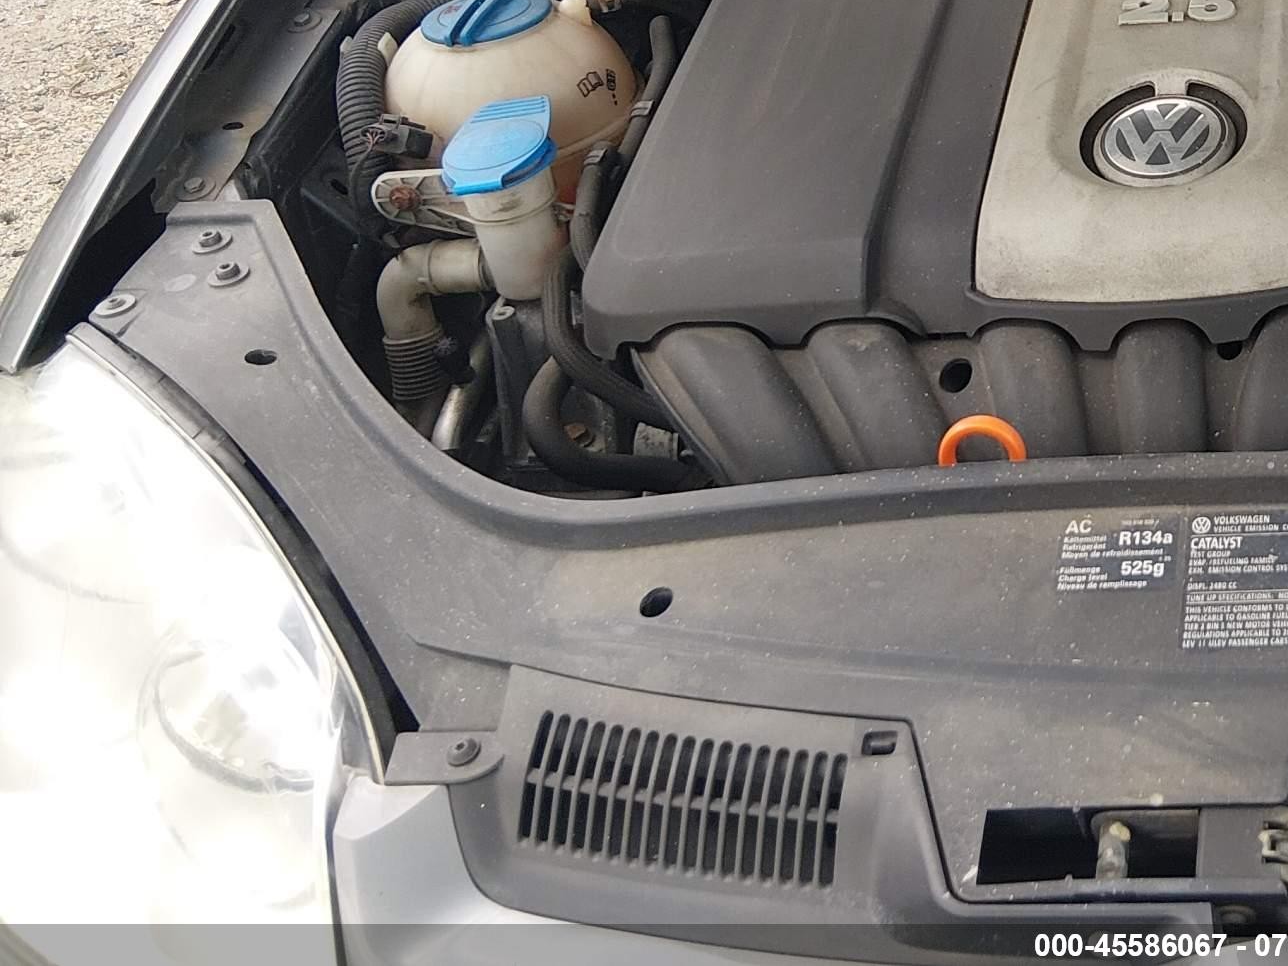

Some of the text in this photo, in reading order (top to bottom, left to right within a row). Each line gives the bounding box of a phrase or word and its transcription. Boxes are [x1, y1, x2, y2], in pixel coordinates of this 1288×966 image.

[1213, 515, 1270, 525] VOLKSWAGEN
[1065, 519, 1092, 534] AC
[1213, 525, 1242, 533] VEHICLE
[1245, 524, 1279, 532] EMISSION
[1119, 530, 1173, 545] R134a
[1190, 536, 1243, 549] CATALYST
[1121, 559, 1165, 577] 525g
[1243, 564, 1274, 573] CONTROL
[1274, 603, 1284, 611] TO
[1225, 613, 1235, 621] TO
[1271, 628, 1281, 636] TO
[1228, 637, 1268, 646] PASSENGER
